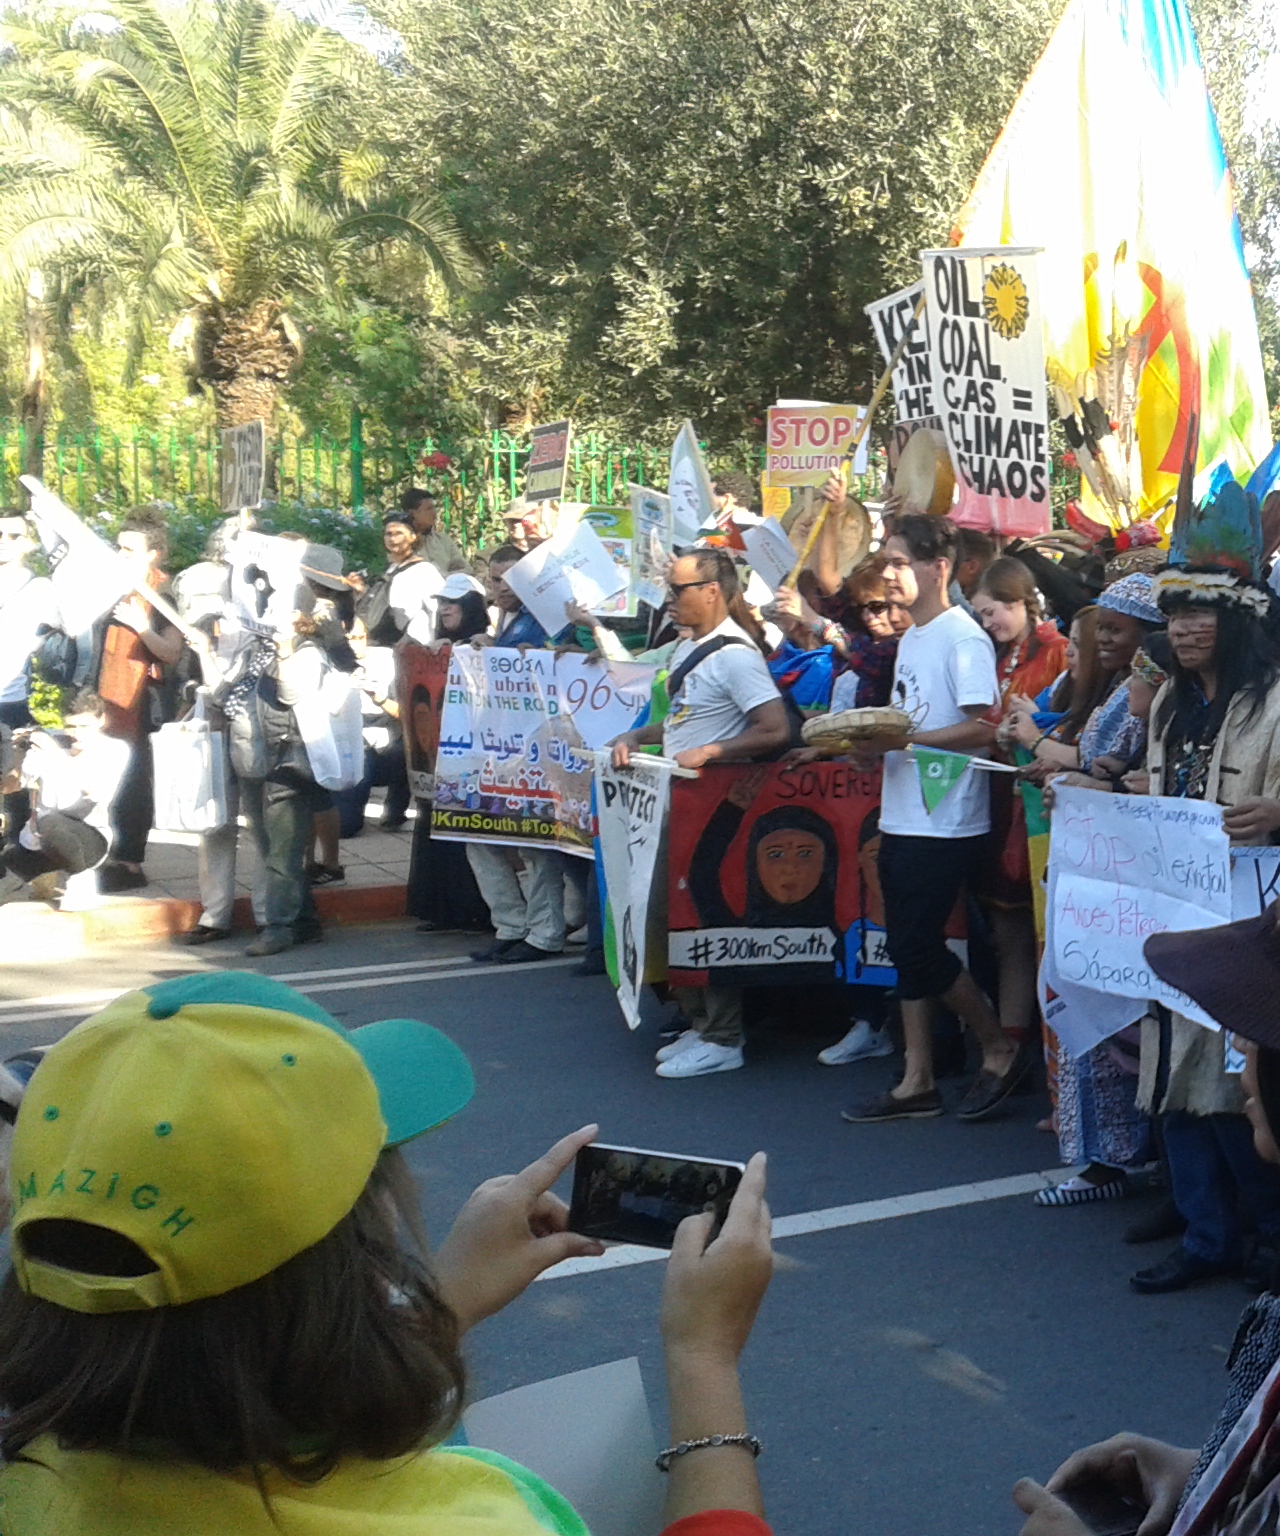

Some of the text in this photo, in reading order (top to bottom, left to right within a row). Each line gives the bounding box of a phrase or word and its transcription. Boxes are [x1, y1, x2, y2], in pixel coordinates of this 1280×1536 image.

[943, 377, 996, 413] GAS
[771, 418, 851, 447] STOP
[950, 412, 1046, 463] CLIMATE
[957, 452, 1046, 502] CHAOS
[10, 1167, 194, 1237] MAZIGH
